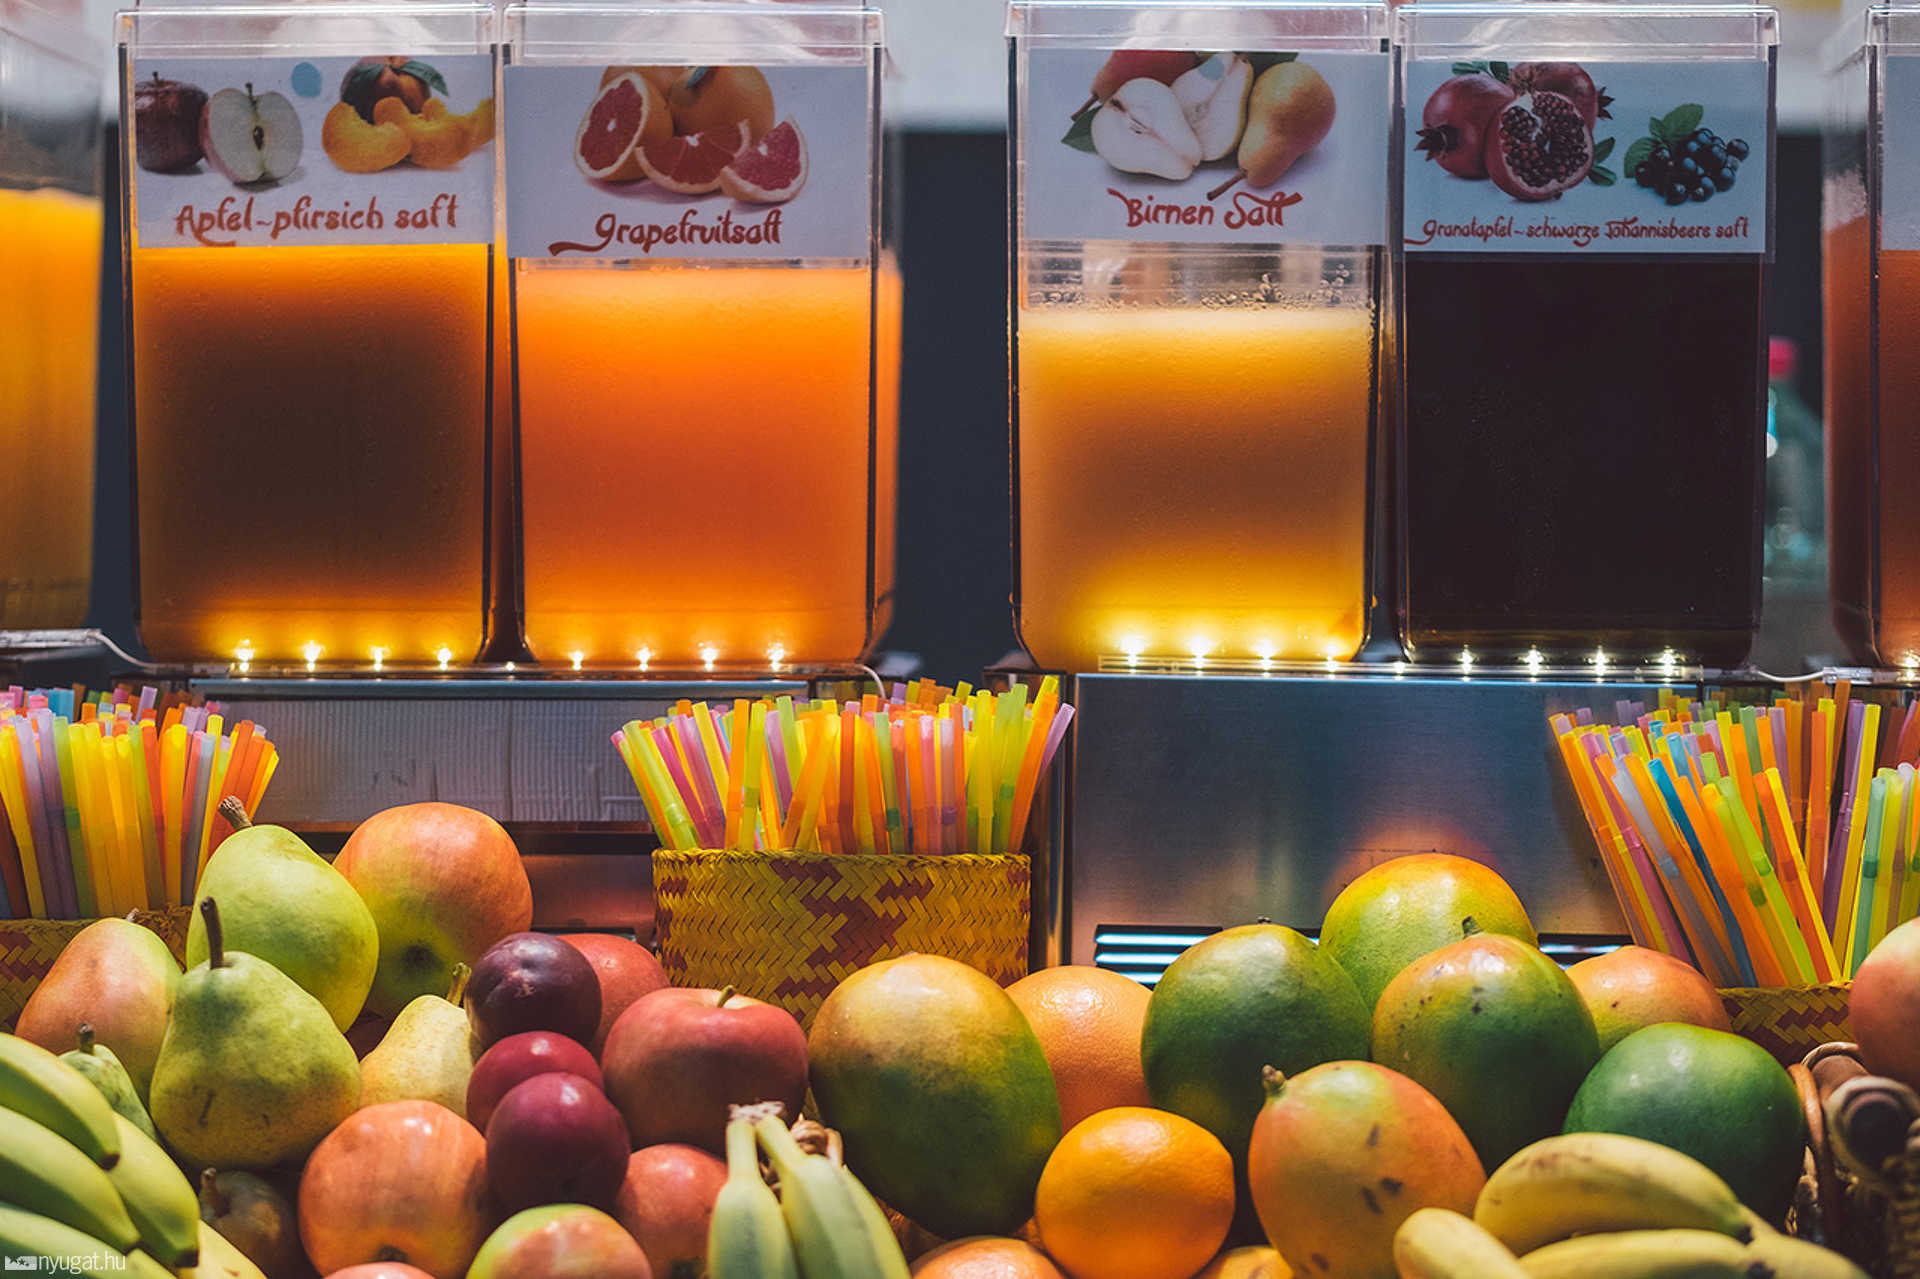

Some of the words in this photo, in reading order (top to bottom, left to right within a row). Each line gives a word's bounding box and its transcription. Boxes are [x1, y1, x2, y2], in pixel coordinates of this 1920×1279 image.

[394, 193, 459, 229] saft
[1107, 188, 1215, 228] Birnen
[1224, 191, 1303, 230] Saft
[1715, 215, 1749, 239] saft
